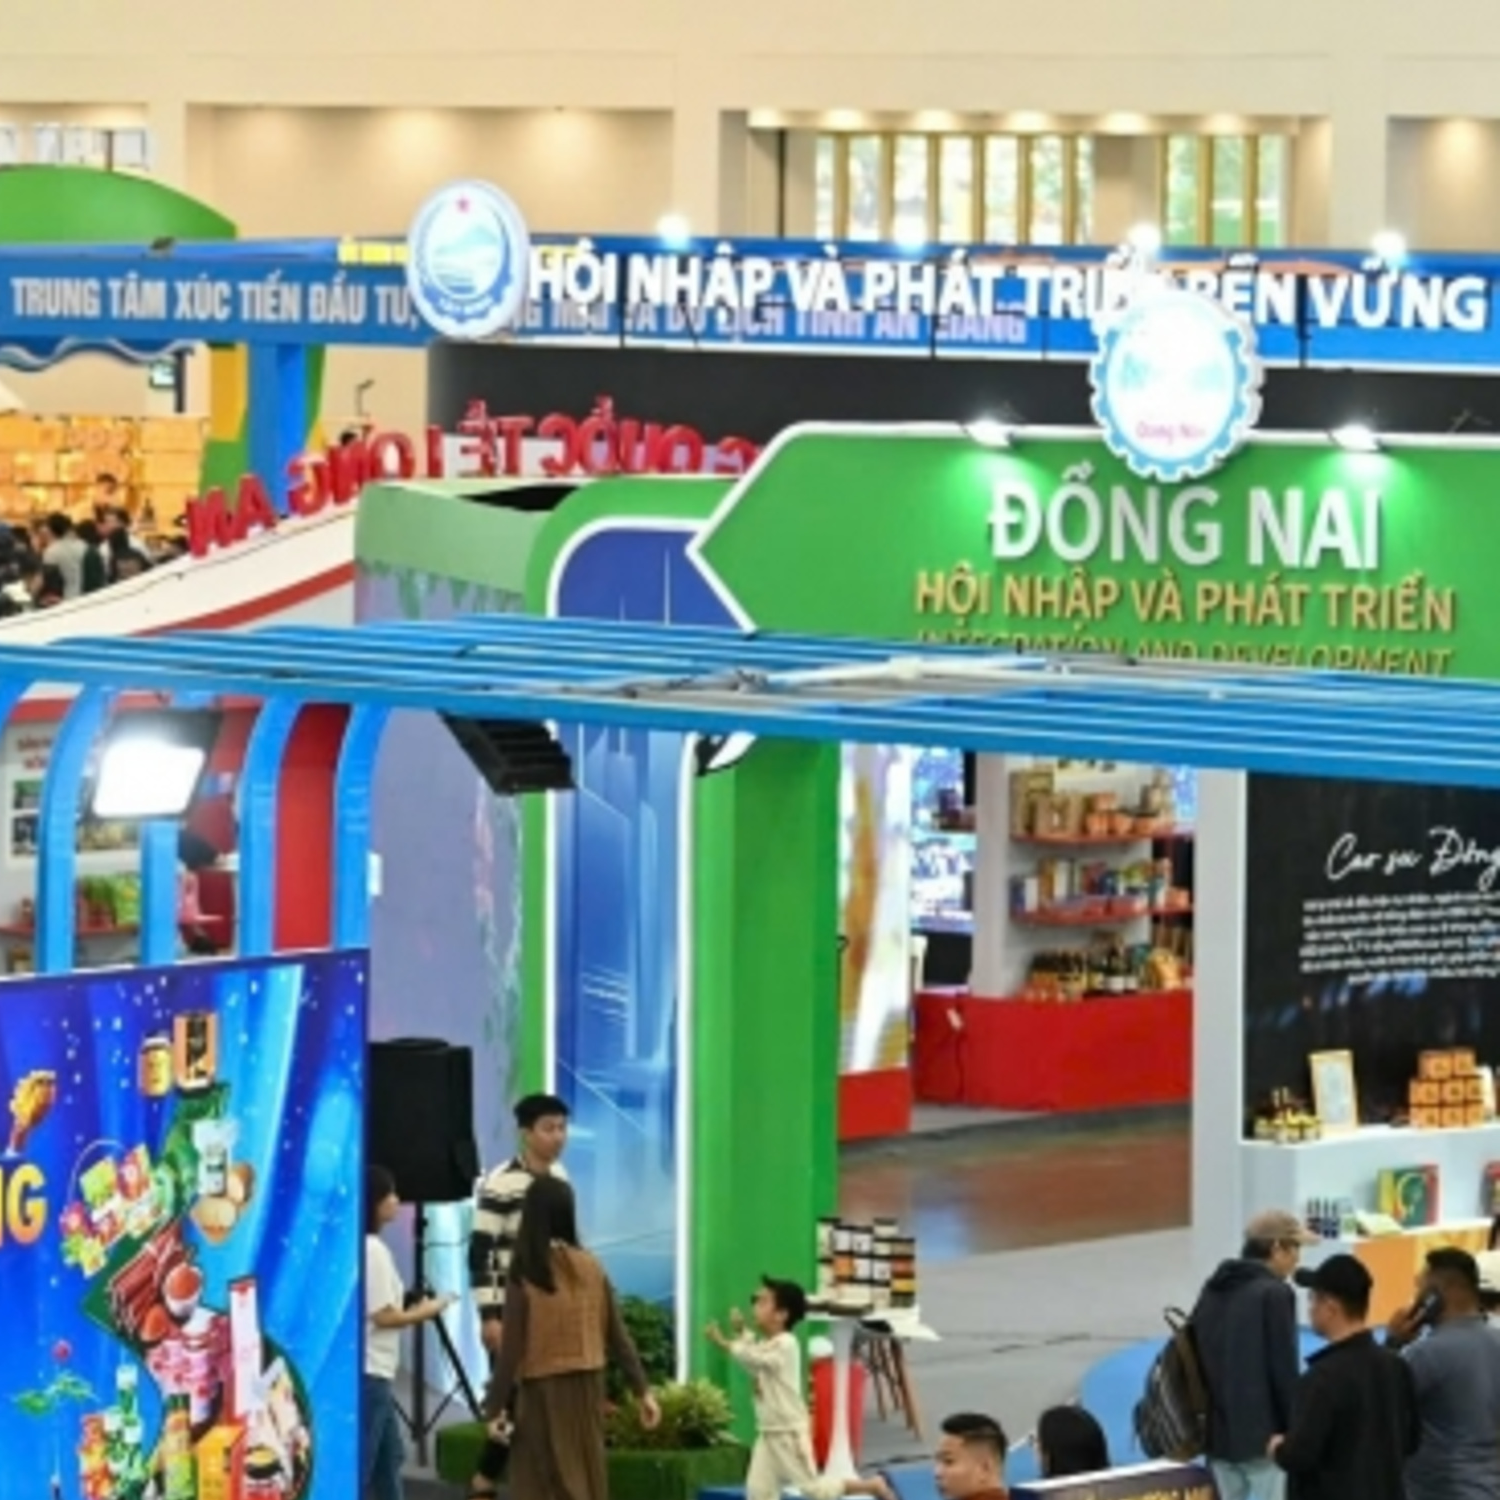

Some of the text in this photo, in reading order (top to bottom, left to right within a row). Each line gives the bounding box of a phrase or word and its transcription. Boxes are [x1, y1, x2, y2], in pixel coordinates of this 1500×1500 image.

[11, 277, 100, 316] TRUNG
[108, 271, 167, 319] TÂM
[174, 273, 232, 320] XÚC
[238, 268, 301, 323] TIẾN
[528, 238, 618, 317] HỘI
[626, 241, 774, 325] NHẬP
[785, 243, 852, 312] VÀ
[862, 248, 1006, 316] PHÁT
[1306, 256, 1490, 331] VỮNG
[986, 461, 1382, 569] ĐỒNG NAI
[914, 560, 1458, 632] HỘI NHẬP VÀ PHÁT TRIỂN
